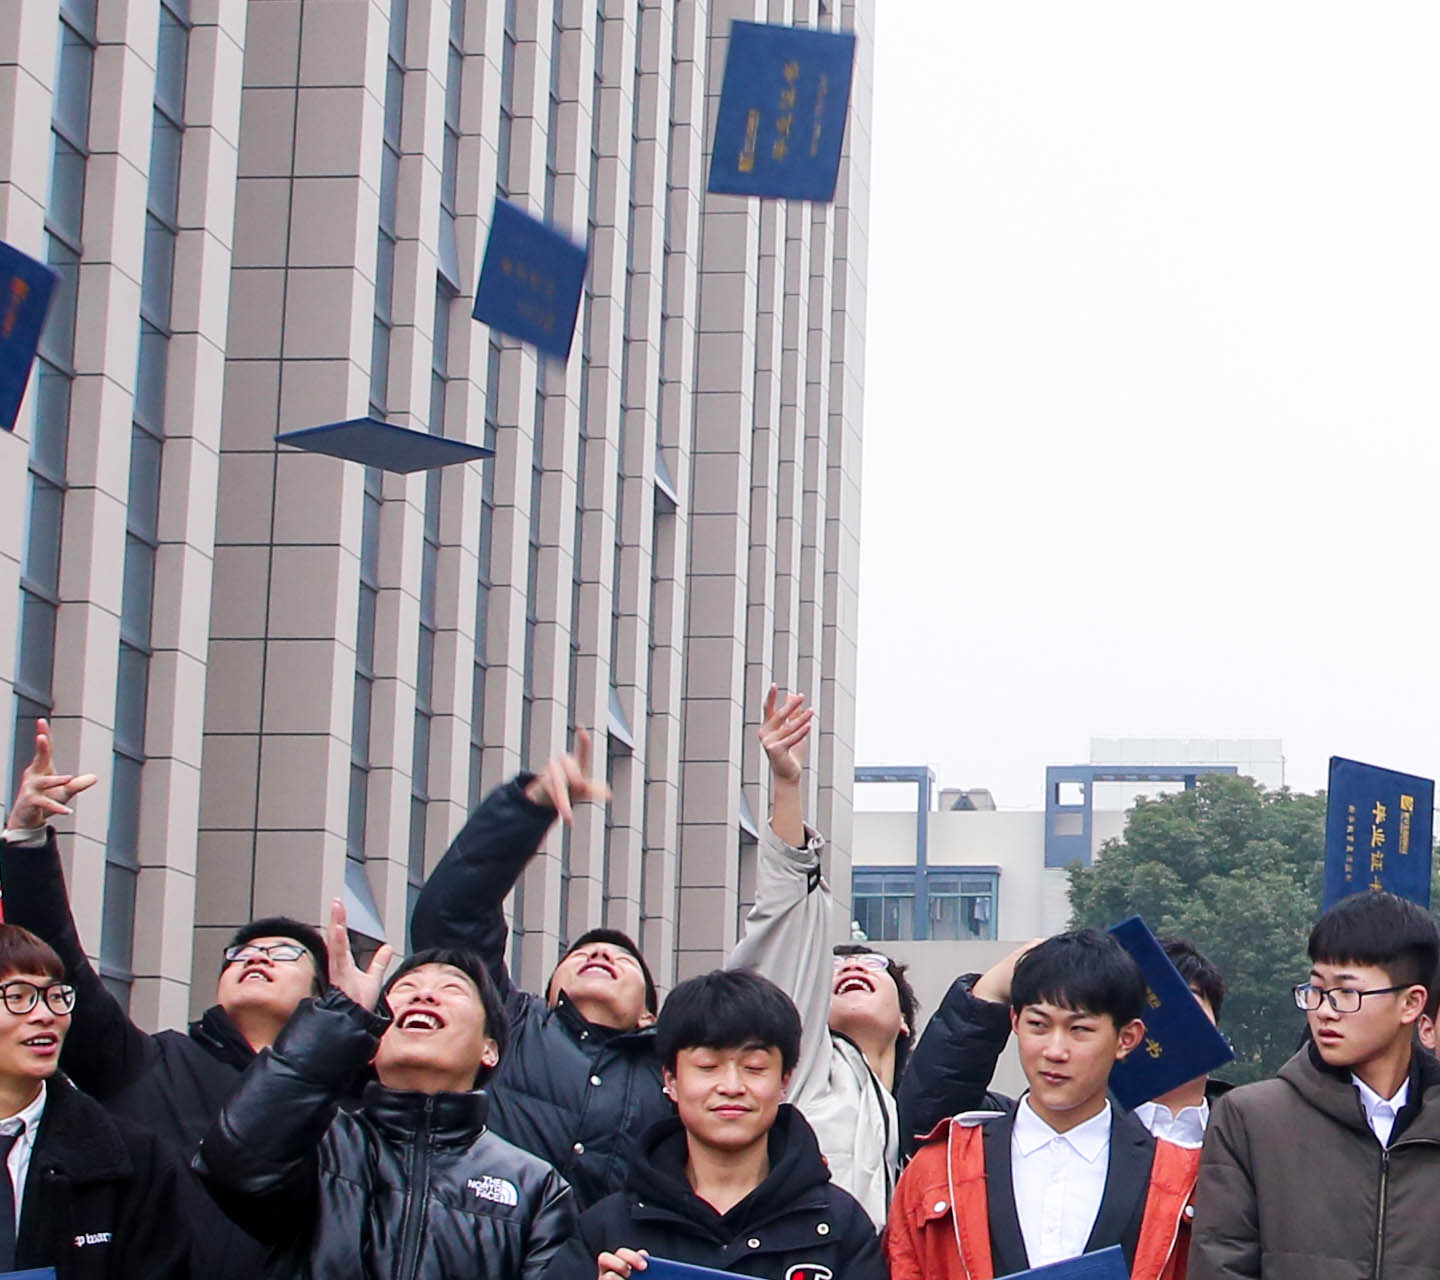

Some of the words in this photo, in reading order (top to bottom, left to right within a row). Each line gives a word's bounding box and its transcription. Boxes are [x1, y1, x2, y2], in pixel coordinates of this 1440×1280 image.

[467, 1179, 501, 1195] NORTH
[482, 1175, 500, 1187] THE
[476, 1188, 501, 1203] FACE
